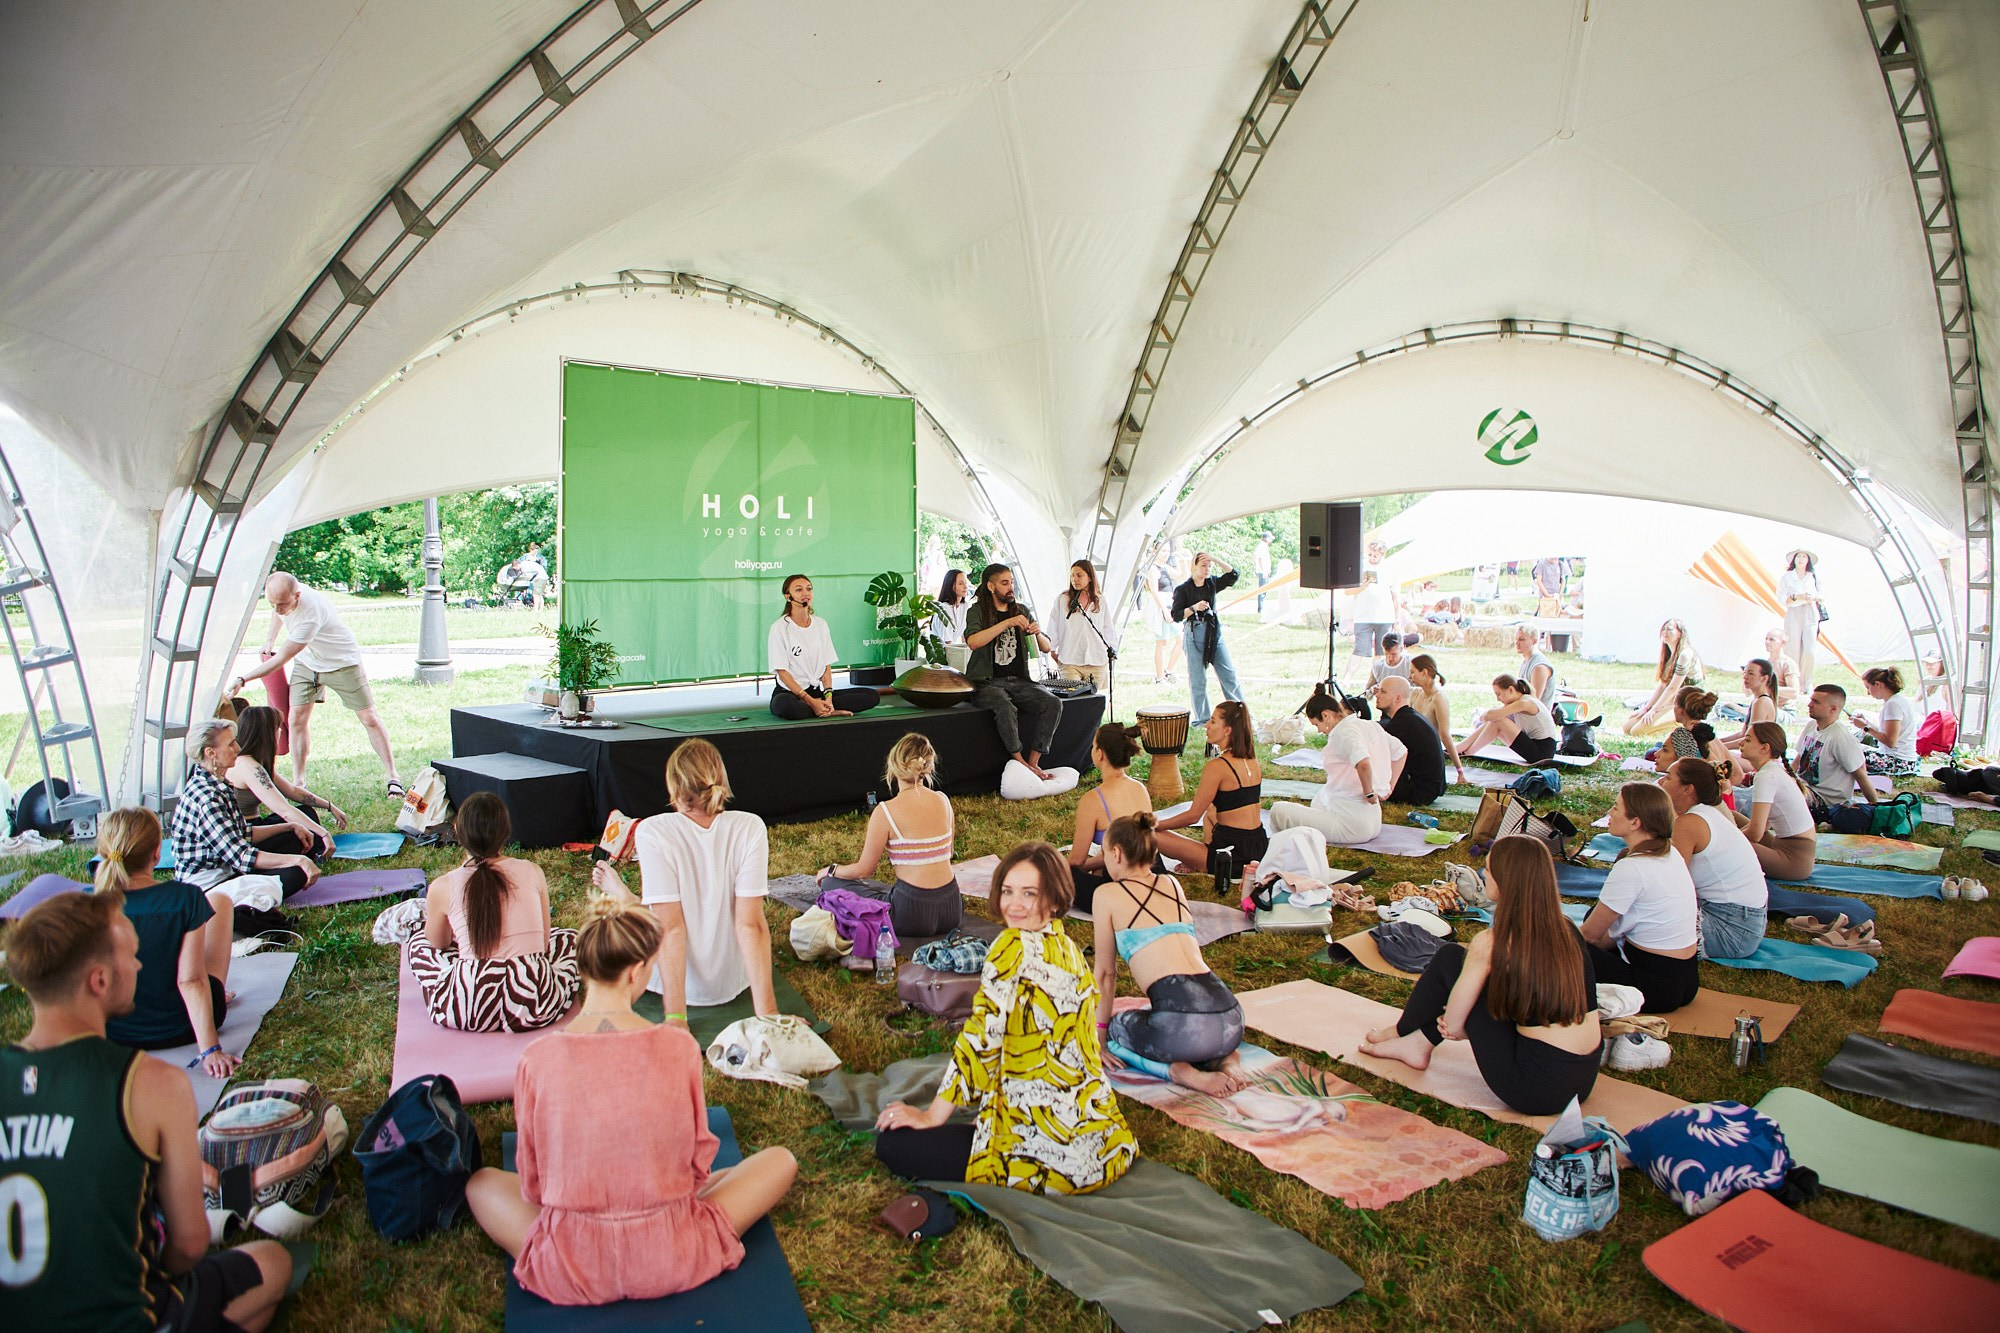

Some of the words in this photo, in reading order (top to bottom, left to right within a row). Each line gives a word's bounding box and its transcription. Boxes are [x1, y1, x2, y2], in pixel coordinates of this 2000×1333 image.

[702, 493, 813, 520] HOLI
[703, 526, 748, 538] yoga
[759, 526, 767, 537] &
[774, 526, 813, 537] cafe
[734, 560, 783, 572] holiyoga.ru
[0, 1172, 49, 1288] 0
